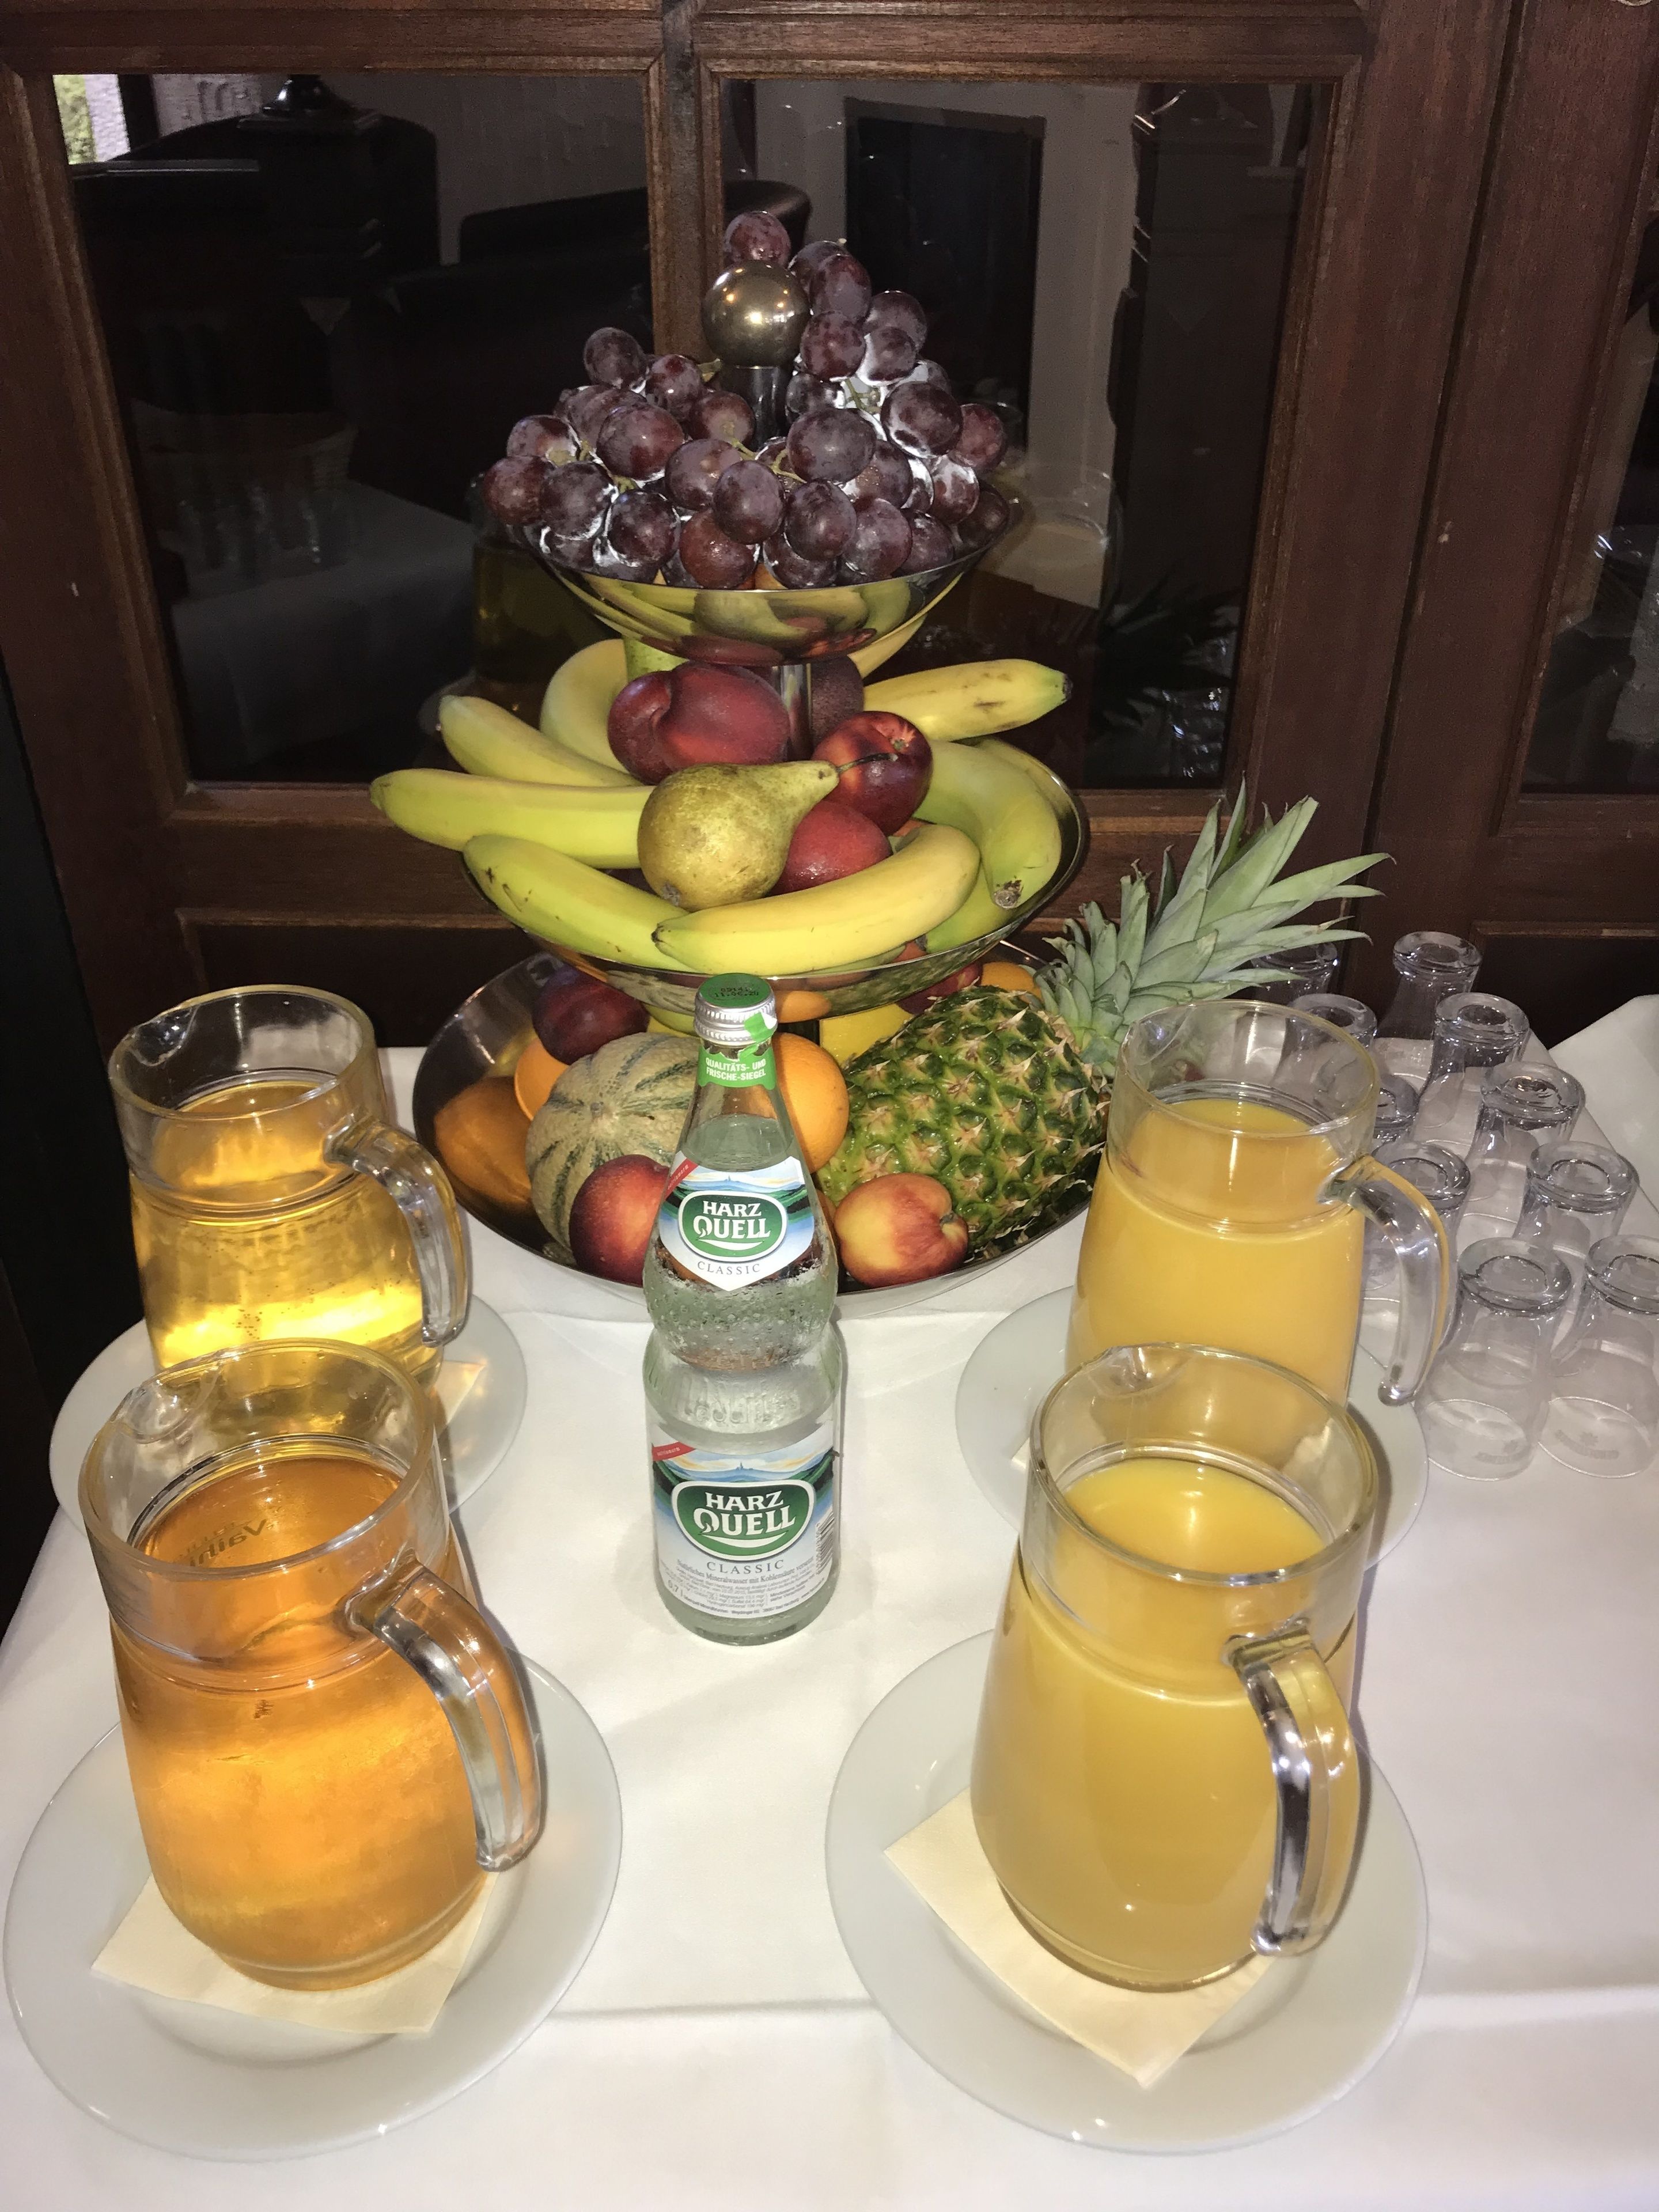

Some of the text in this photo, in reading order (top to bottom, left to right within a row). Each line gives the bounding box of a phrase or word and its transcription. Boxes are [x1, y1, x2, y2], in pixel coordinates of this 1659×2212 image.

[706, 1058, 766, 1072] QUALITÄTS- UND
[706, 1068, 766, 1081] FRISCHE-SIEGEL
[702, 1200, 762, 1218] HARZ
[693, 1215, 771, 1240] QUELL
[698, 1260, 761, 1275] CLASSIC
[705, 1490, 784, 1512] HARZ
[694, 1505, 797, 1536] QUELL
[707, 1559, 784, 1574] CLASSIC
[706, 1573, 748, 1584] Mineralwasser
